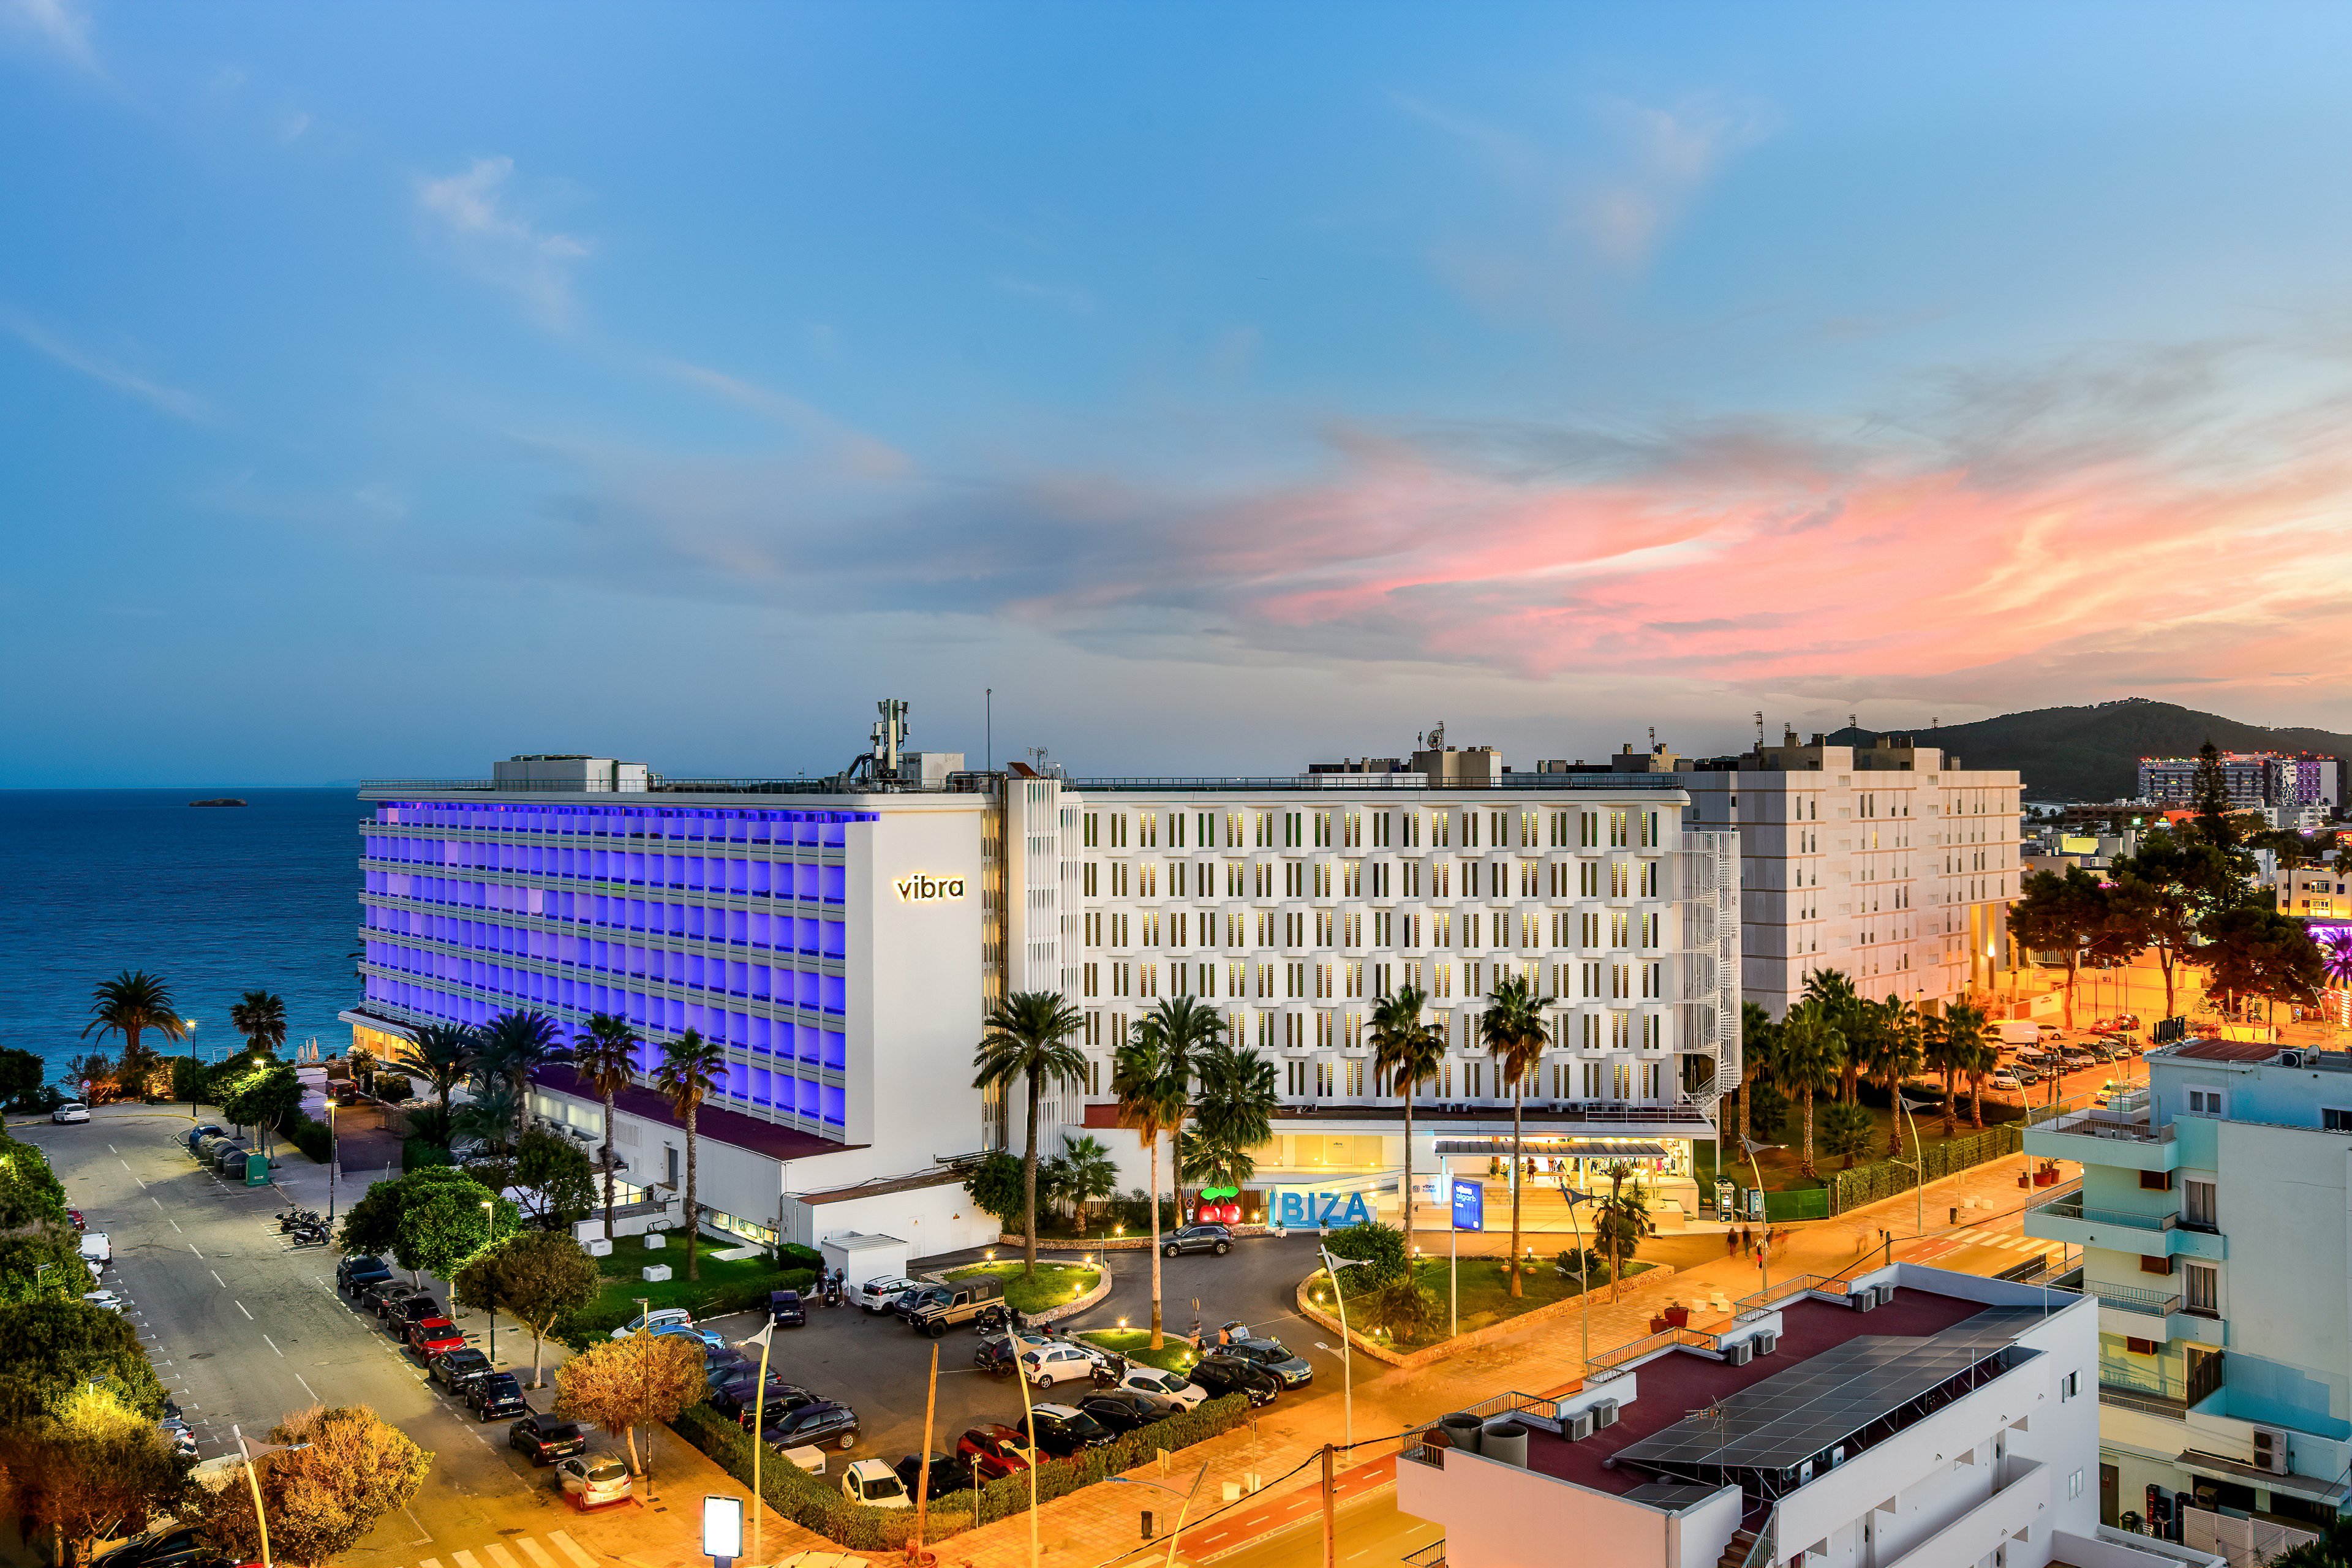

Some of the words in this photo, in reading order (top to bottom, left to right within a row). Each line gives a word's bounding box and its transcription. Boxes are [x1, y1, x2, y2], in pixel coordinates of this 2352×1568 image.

[896, 874, 964, 900] vibra
[1268, 1192, 1370, 1223] IBIZA
[1456, 1193, 1476, 1202] algarb
